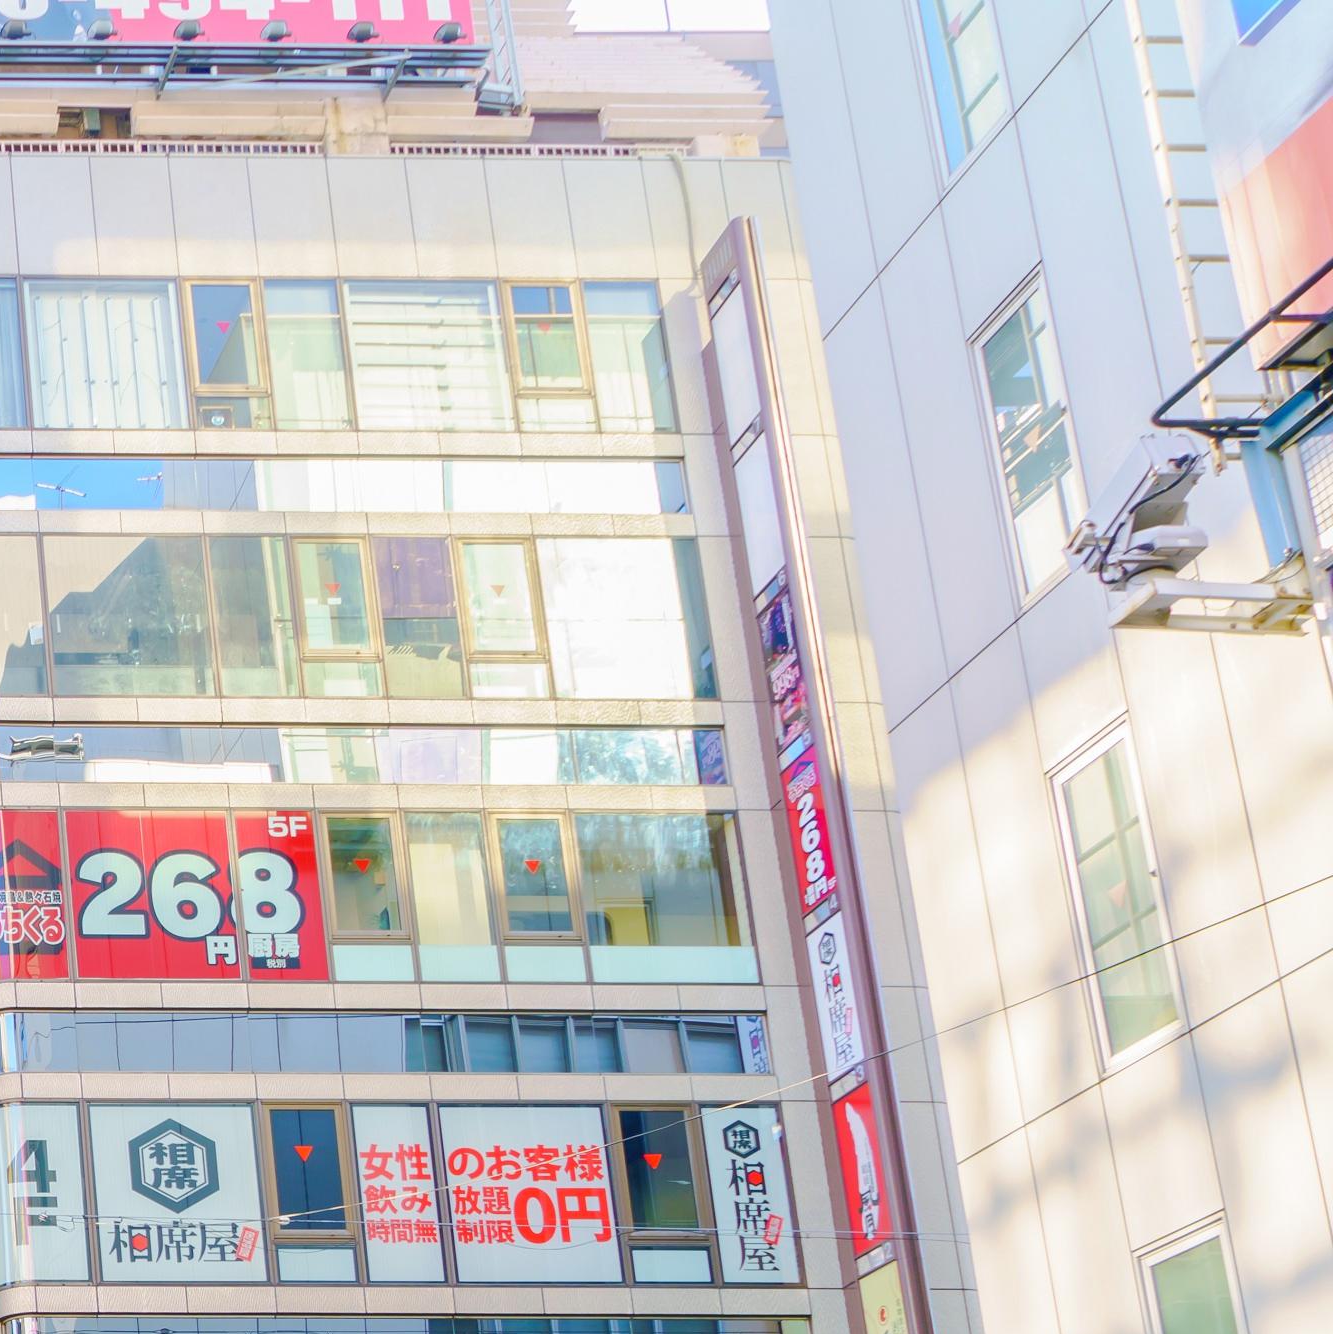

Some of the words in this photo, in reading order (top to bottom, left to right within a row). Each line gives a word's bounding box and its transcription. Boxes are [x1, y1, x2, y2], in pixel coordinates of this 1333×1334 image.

[266, 815, 308, 838] 5F
[797, 792, 826, 883] 268
[75, 847, 306, 942] 268
[108, 1220, 244, 1264] 相席屋
[513, 1186, 613, 1246] 0円
